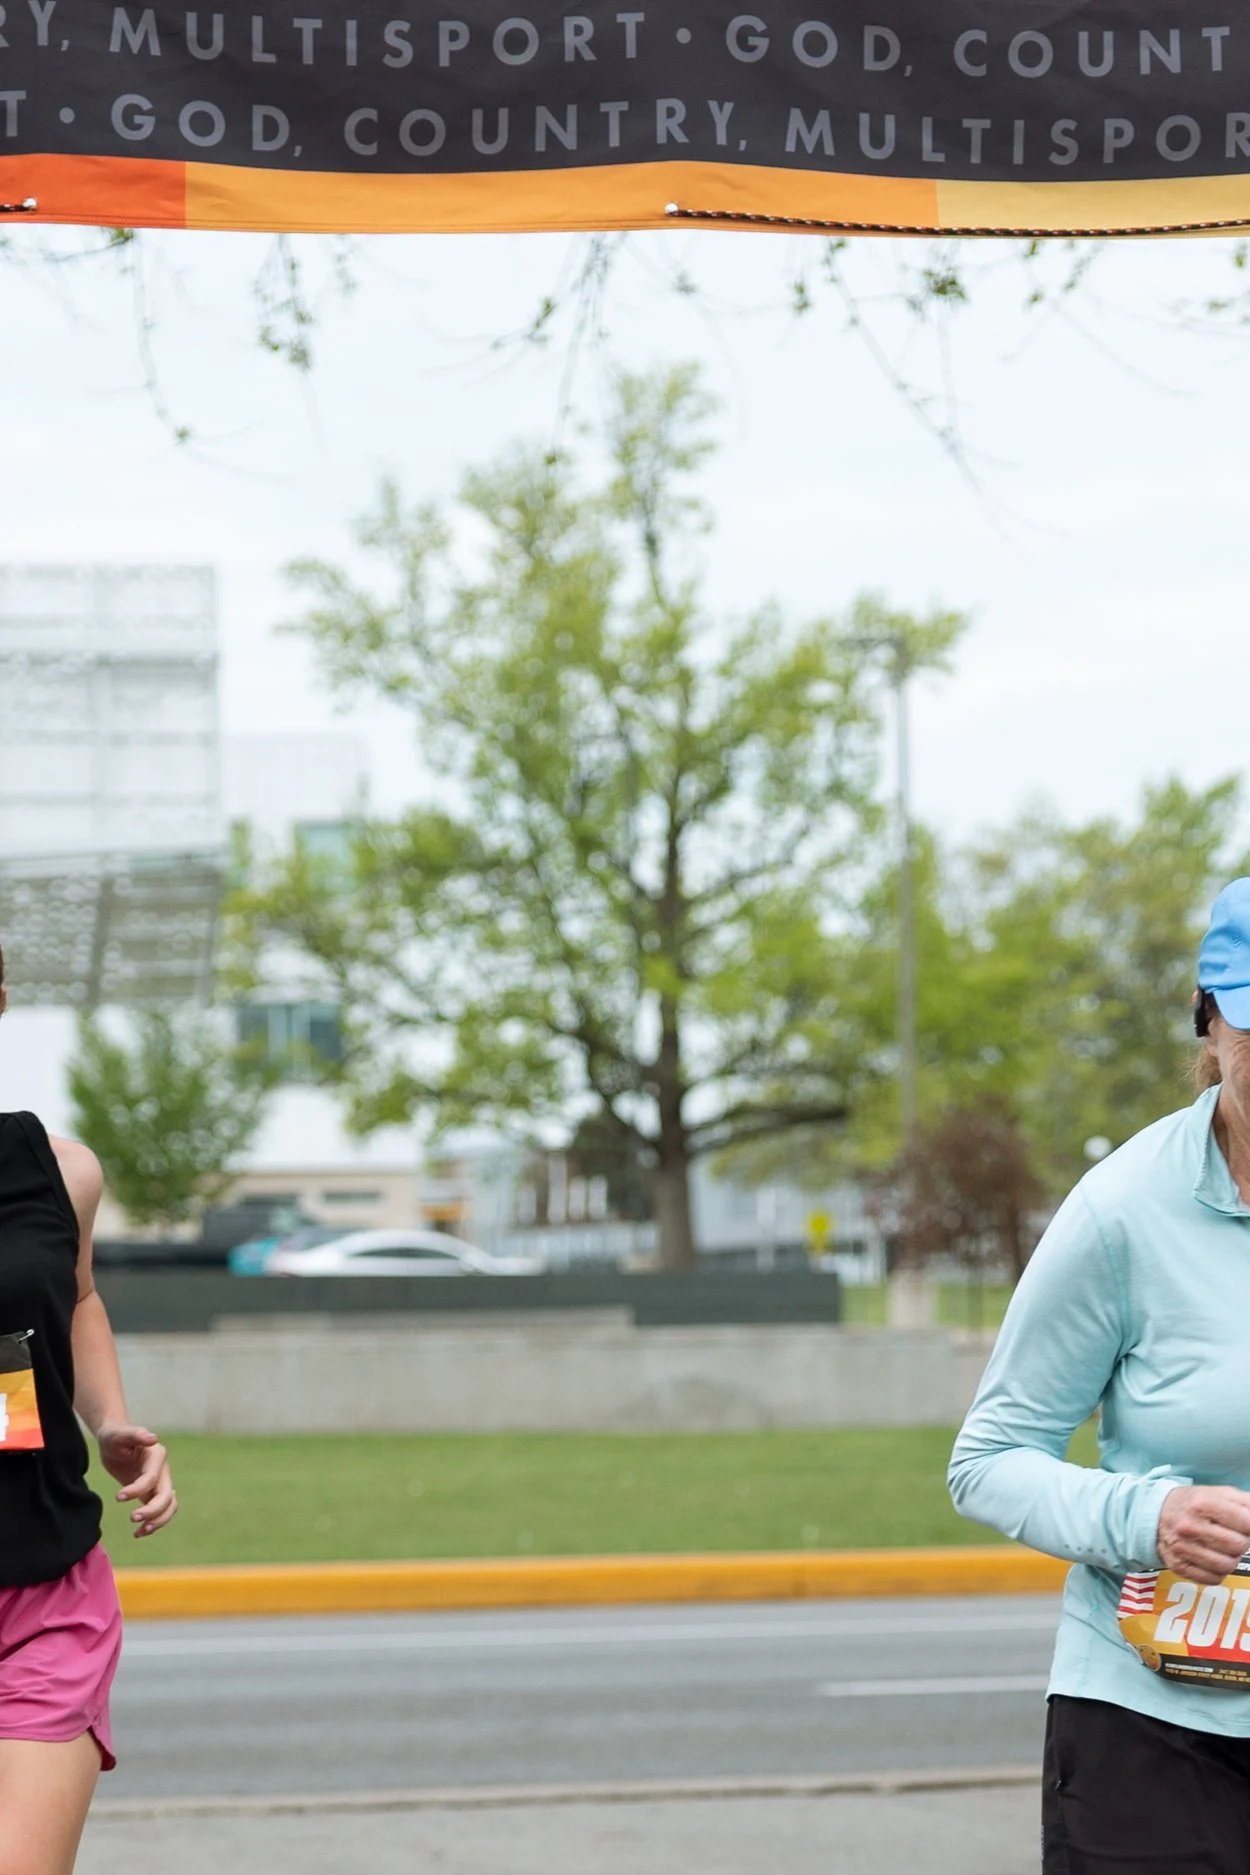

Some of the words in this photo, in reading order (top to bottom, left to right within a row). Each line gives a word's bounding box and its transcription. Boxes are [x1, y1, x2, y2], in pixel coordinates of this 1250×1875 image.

[109, 7, 645, 69] MULTISPORT
[725, 14, 914, 78] GOD,
[110, 94, 302, 158] GOD,
[343, 98, 748, 157] COUNTRY,
